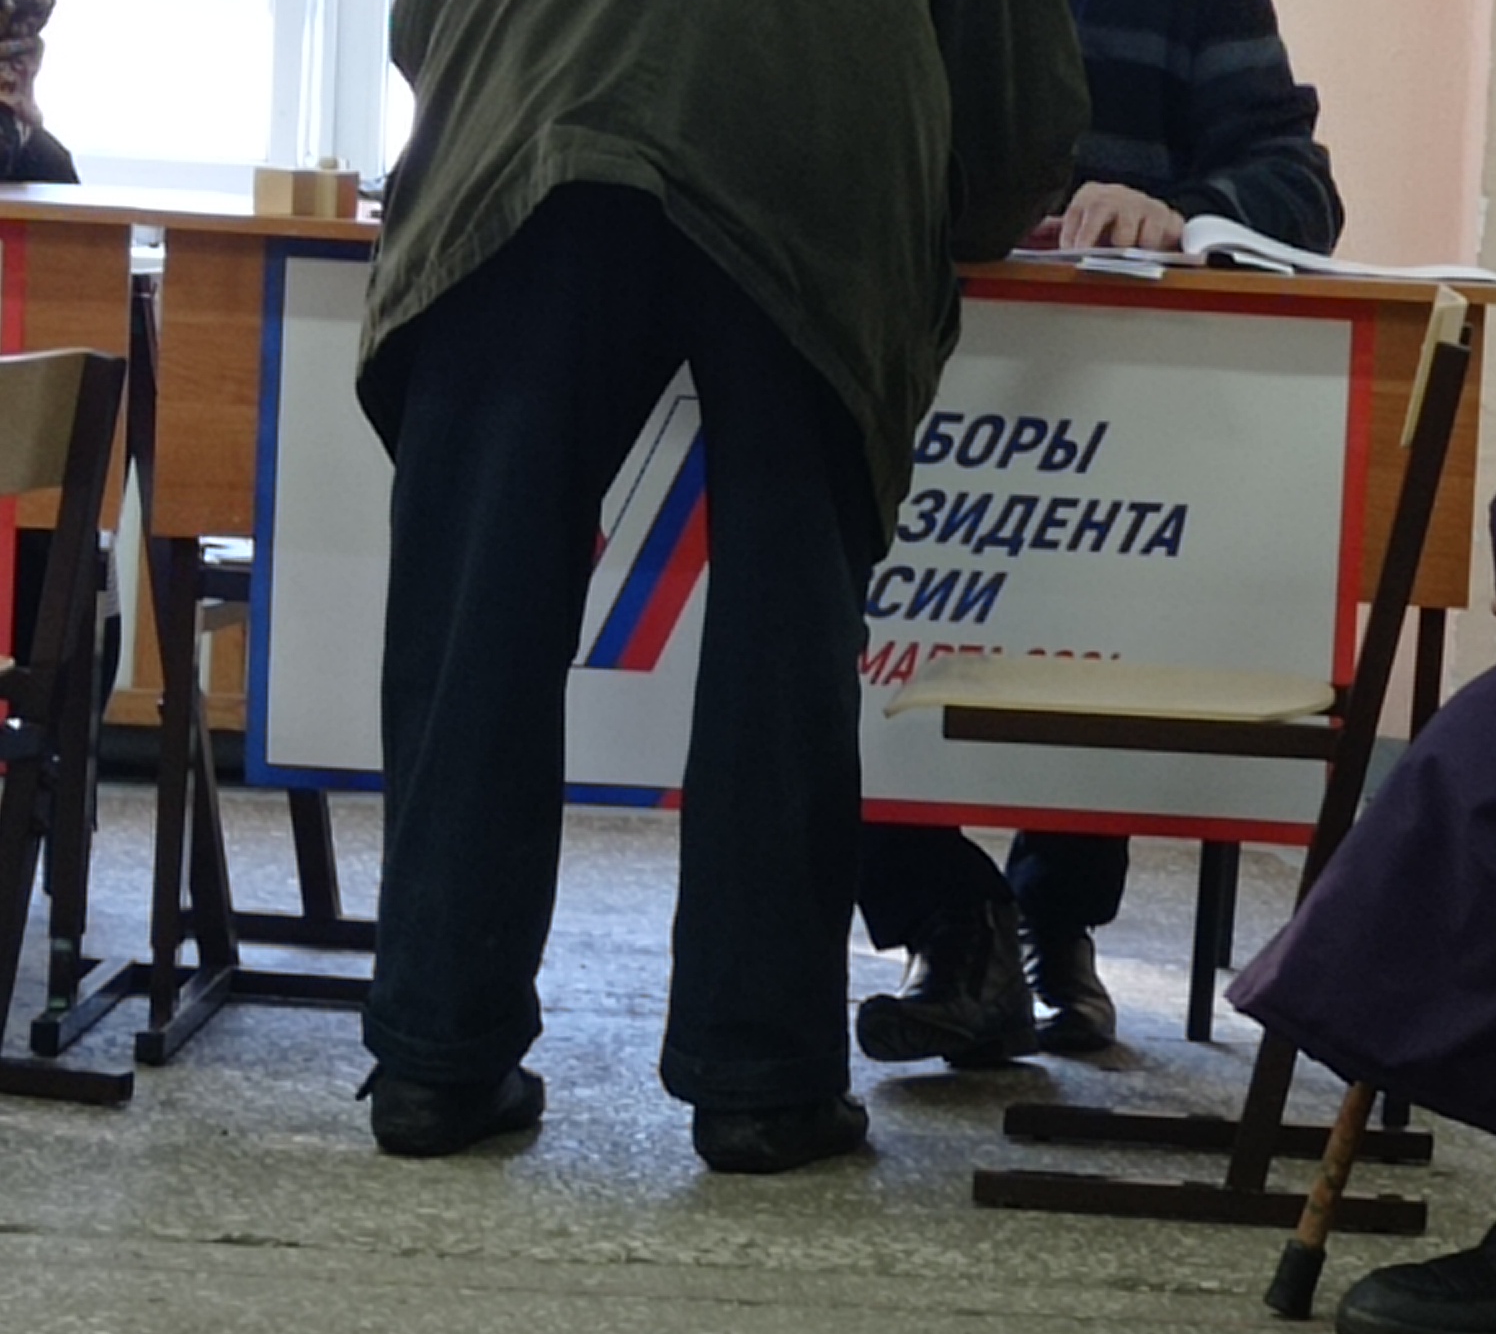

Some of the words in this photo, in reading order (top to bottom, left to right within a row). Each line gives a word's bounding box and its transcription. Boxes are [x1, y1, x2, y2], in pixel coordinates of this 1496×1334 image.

[912, 411, 1110, 474] БОРЫ
[896, 489, 1189, 557] ЗИДЕНТА
[866, 565, 1008, 624] СИИ
